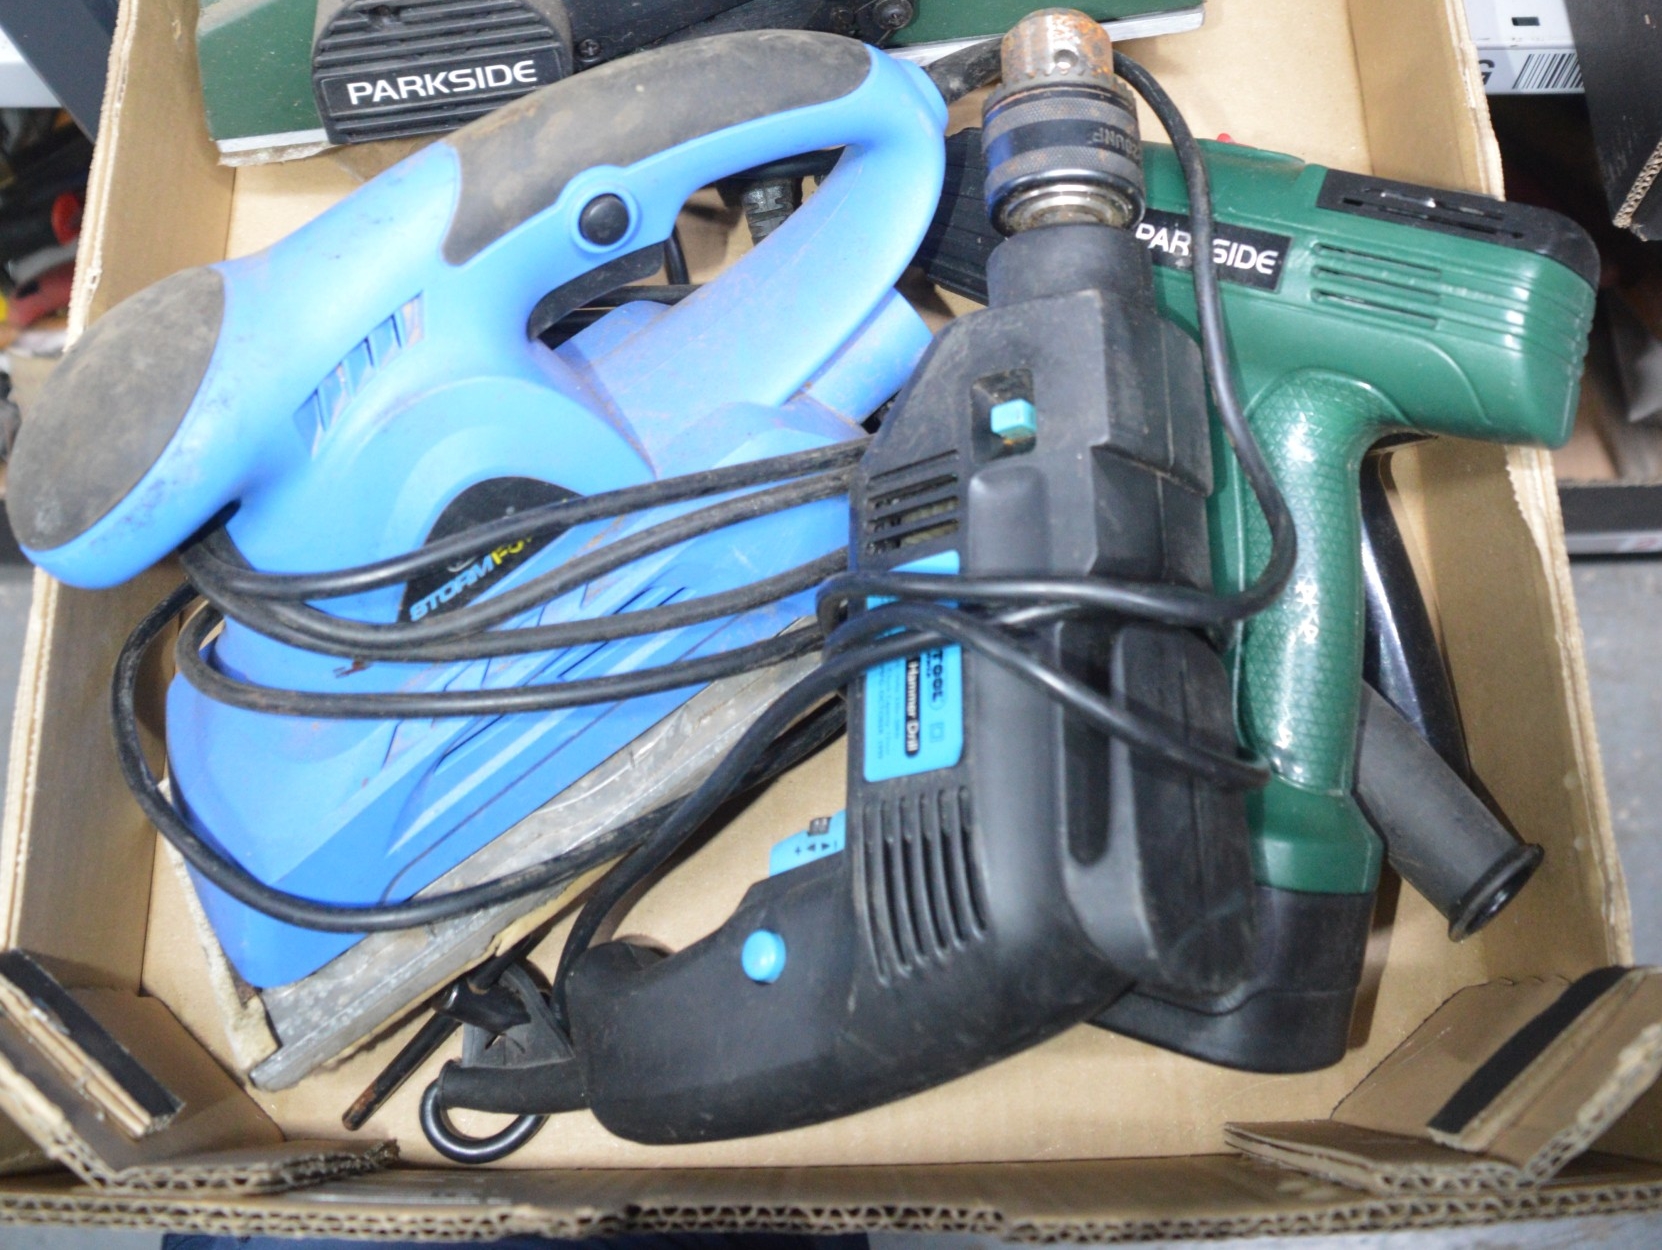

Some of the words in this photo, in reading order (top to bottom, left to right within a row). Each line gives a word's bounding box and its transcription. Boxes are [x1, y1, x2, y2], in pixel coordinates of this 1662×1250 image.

[346, 60, 538, 105] PARKSIDE
[1135, 222, 1279, 275] PARSIDE
[907, 660, 919, 718] Hammer
[907, 719, 919, 752] Drill
